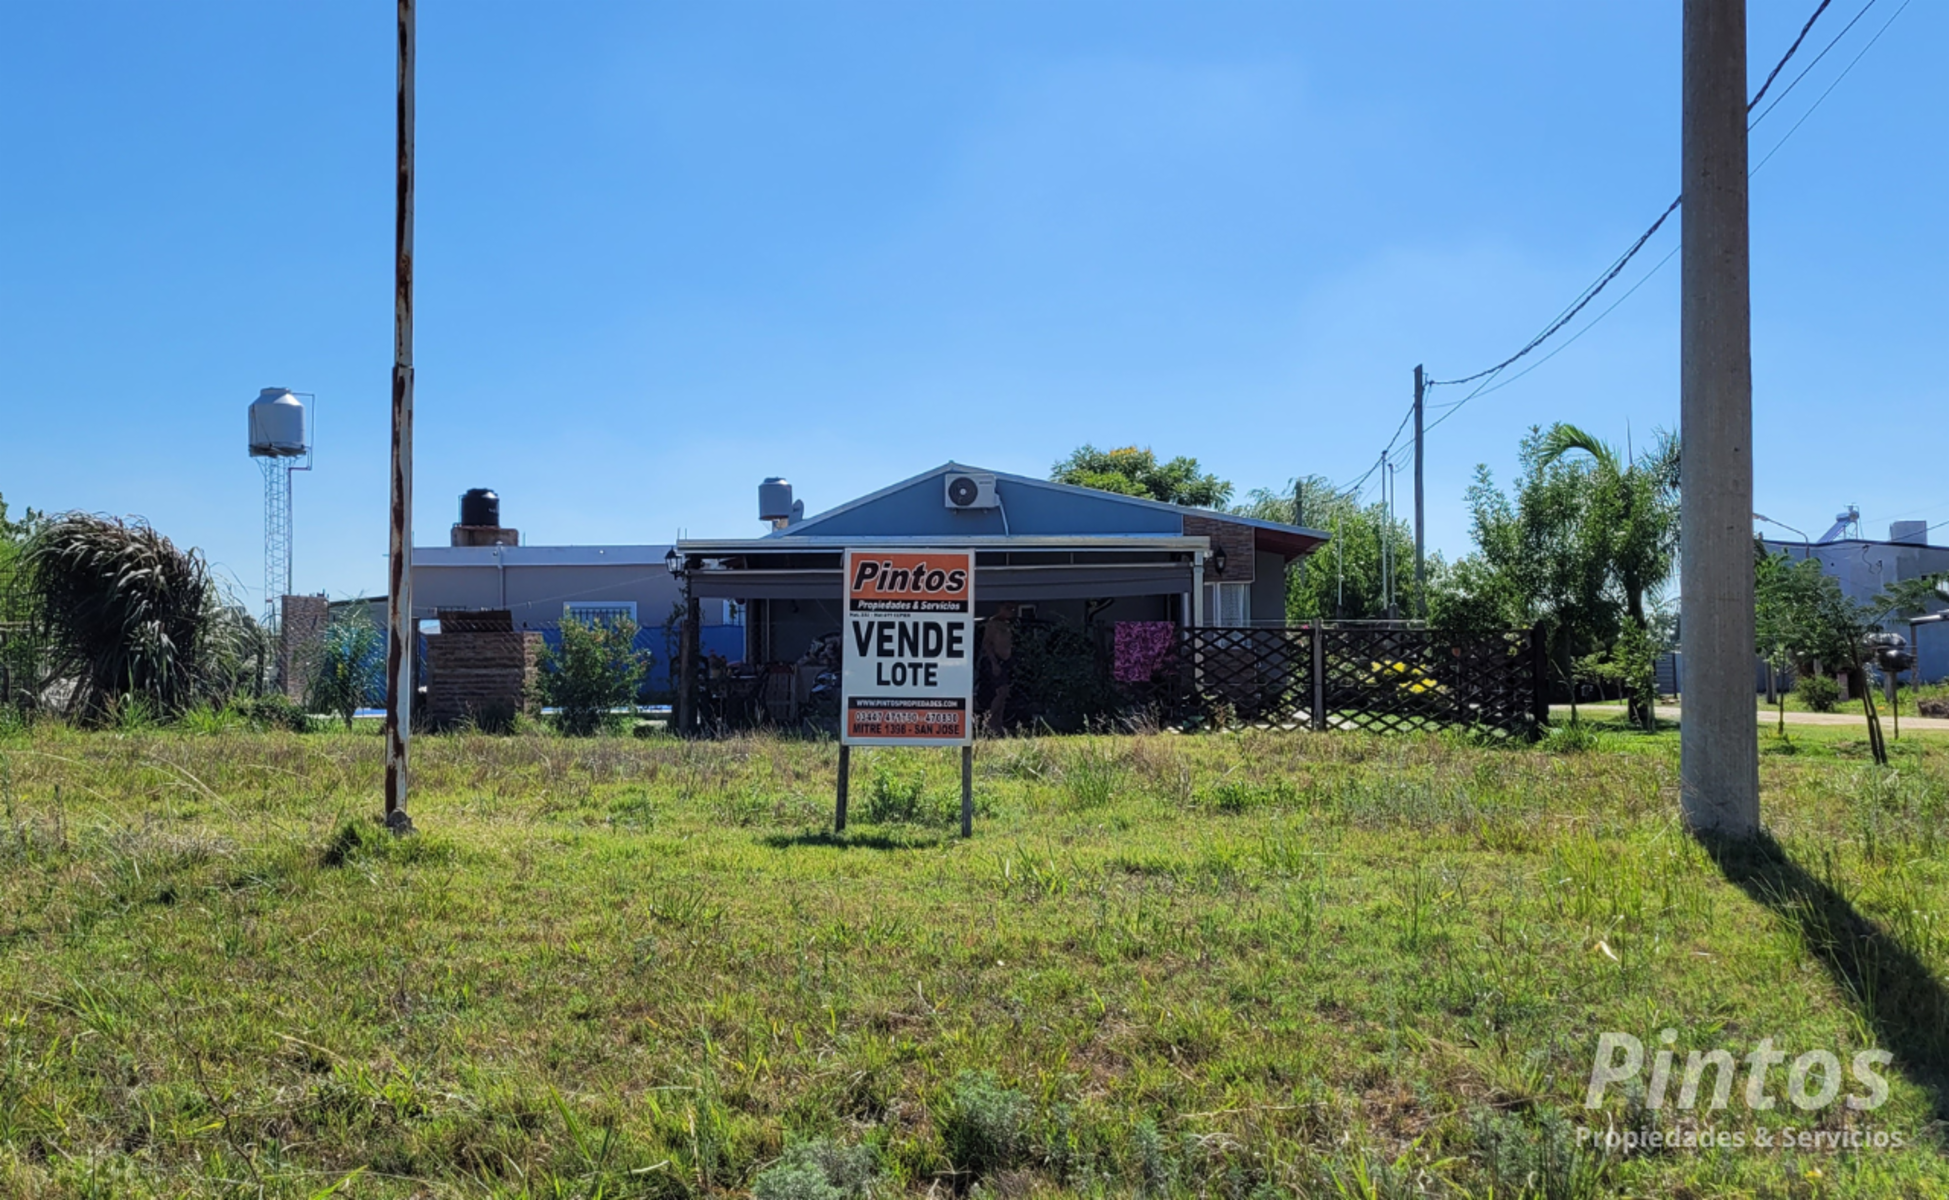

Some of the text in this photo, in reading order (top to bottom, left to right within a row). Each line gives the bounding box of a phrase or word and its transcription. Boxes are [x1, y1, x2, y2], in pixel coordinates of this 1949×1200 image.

[851, 560, 967, 594] Pintos
[857, 600, 960, 611] Propiedades & Servicios
[852, 621, 965, 658] VENDE
[876, 662, 938, 687] LOTE
[852, 723, 882, 734] MITRE
[914, 724, 933, 735] SAN
[935, 724, 960, 735] JOSE
